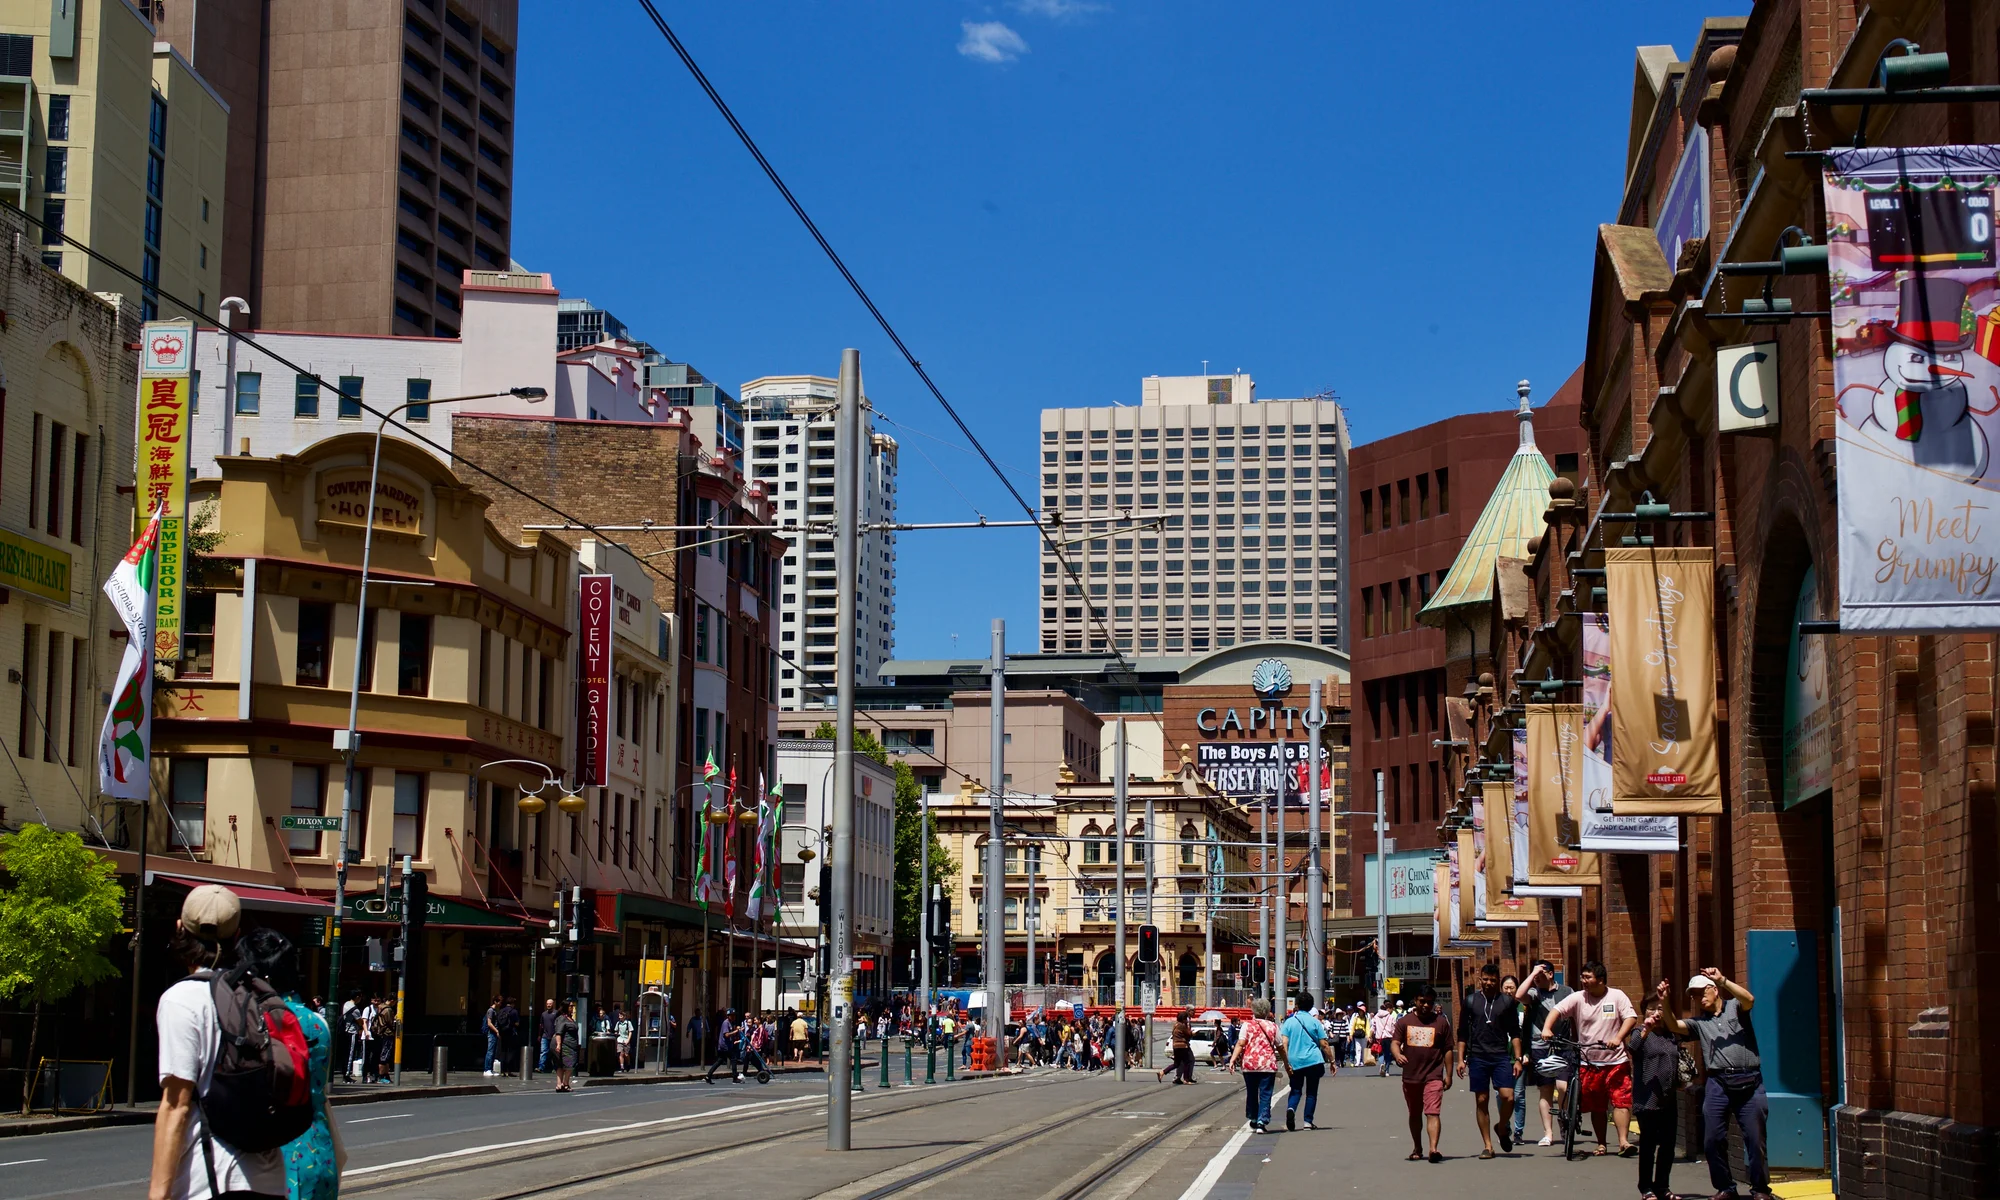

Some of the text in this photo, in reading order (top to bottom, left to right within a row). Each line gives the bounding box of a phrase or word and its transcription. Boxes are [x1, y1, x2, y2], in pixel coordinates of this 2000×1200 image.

[1869, 198, 1900, 210] LEVEL 1
[1971, 212, 1989, 243] 0
[1729, 352, 1768, 419] C
[338, 501, 406, 525] HOTEL
[1891, 496, 1989, 545] Meet
[0, 541, 66, 592] RESTAURANT
[1875, 535, 1999, 596] Grumpy
[589, 581, 602, 672] COVENT
[1643, 573, 1685, 668] Greetings
[179, 689, 205, 711] 太
[585, 689, 599, 781] GARDEN
[1199, 745, 1226, 760] The
[1230, 745, 1266, 763] Boys
[1648, 775, 1685, 783] MARKET CITY
